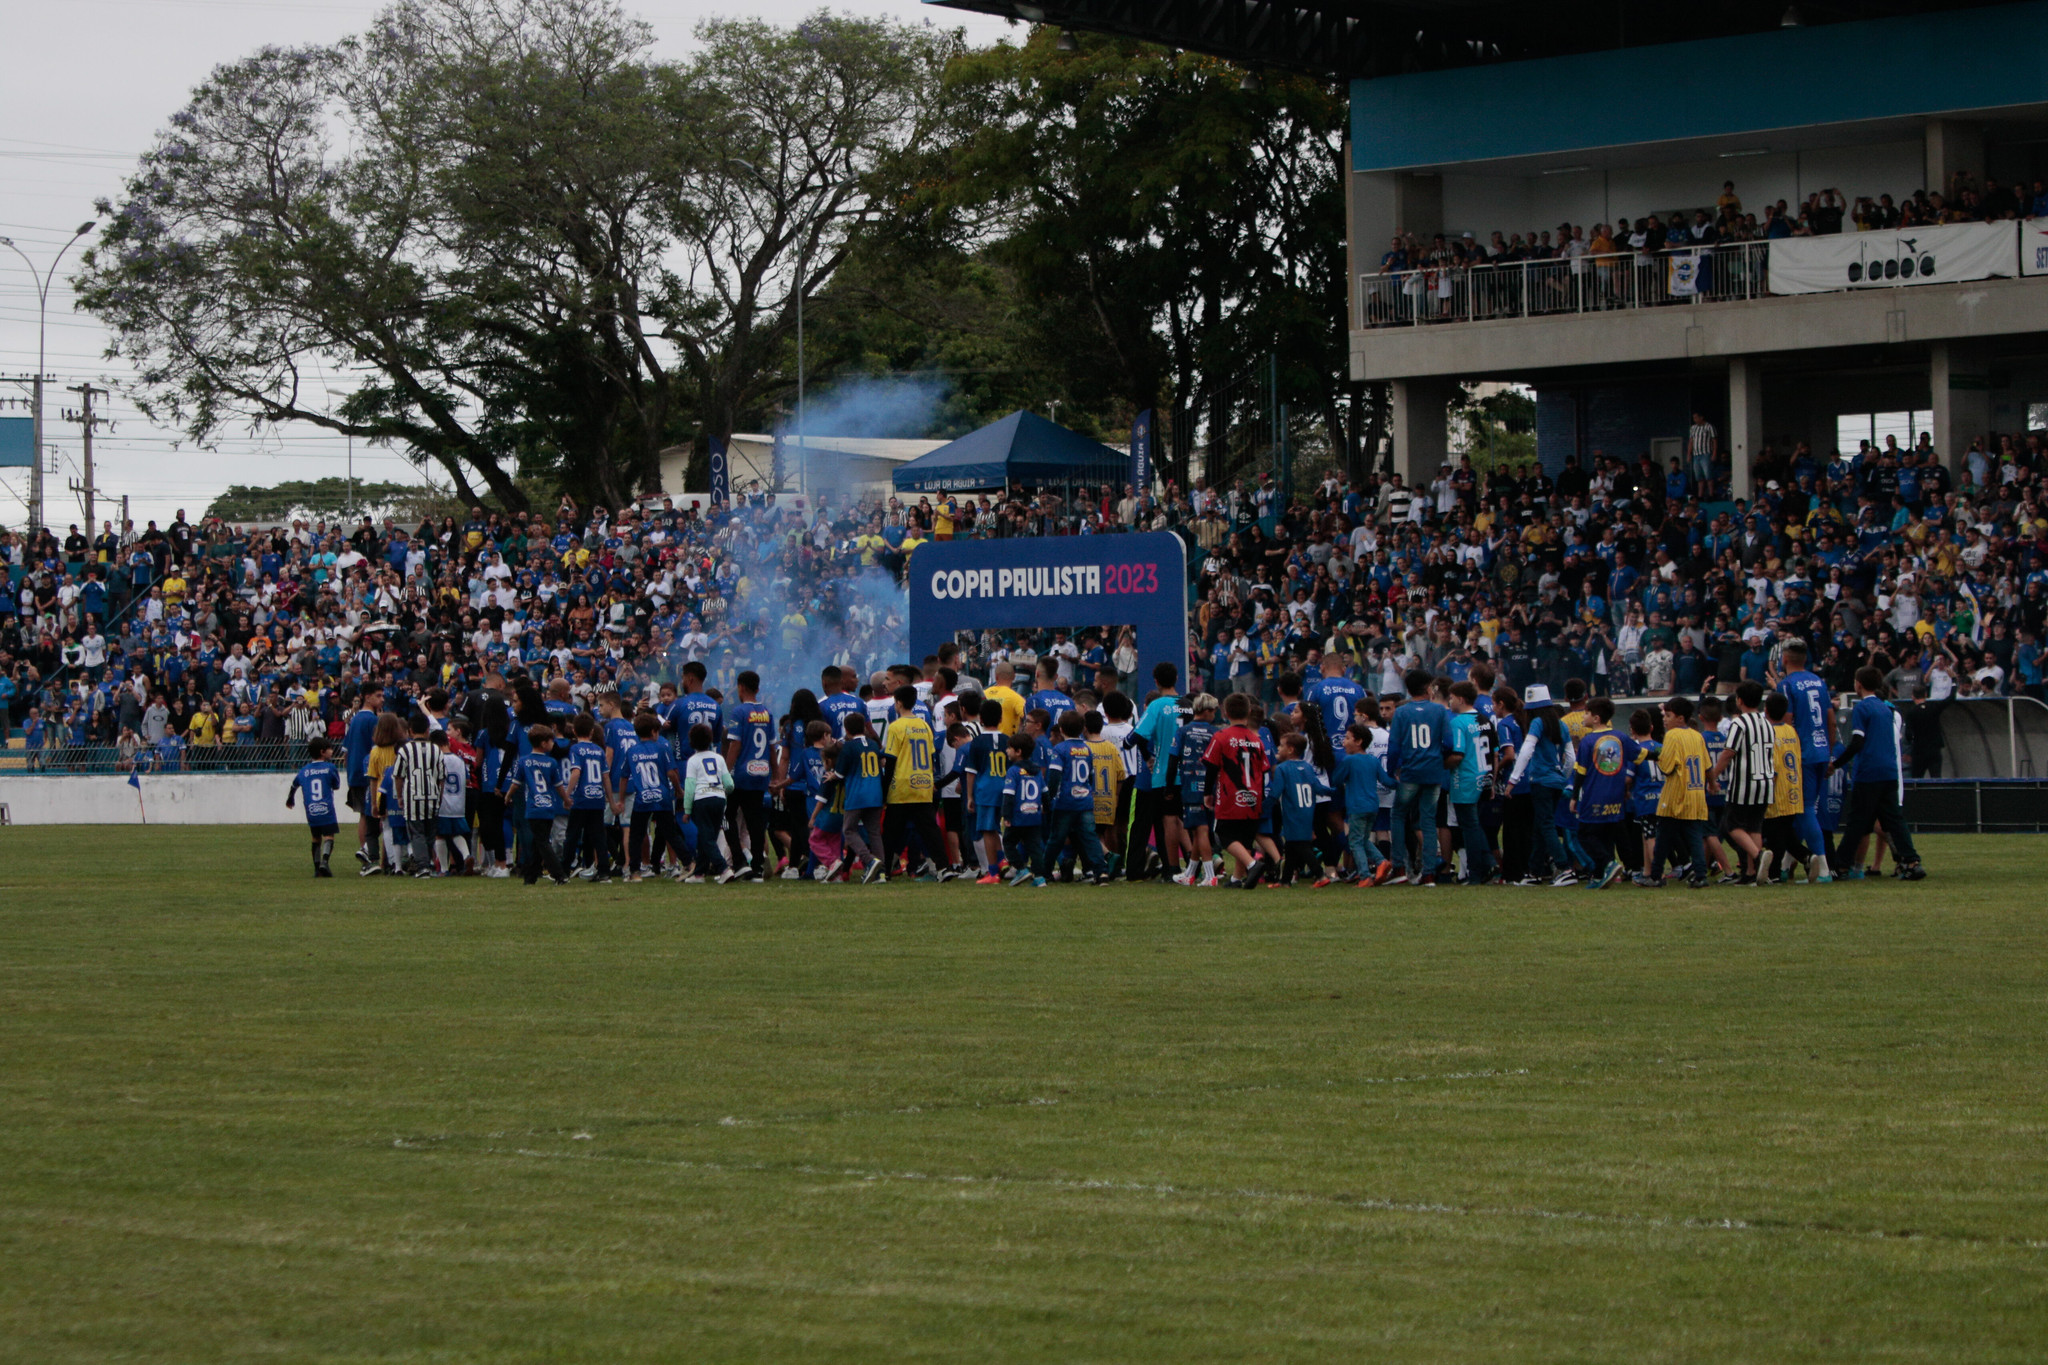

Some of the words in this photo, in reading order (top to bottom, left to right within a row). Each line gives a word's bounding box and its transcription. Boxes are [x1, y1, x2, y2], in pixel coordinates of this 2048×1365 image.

[1848, 238, 1936, 282] diadora
[924, 481, 941, 490] LOJA
[942, 480, 952, 489] DA
[931, 569, 994, 600] COPA
[999, 565, 1100, 597] PAULISTA
[1105, 563, 1159, 594] 2023
[1332, 687, 1356, 695] Sicredi
[696, 702, 716, 710] Sicredi
[1333, 696, 1349, 731] 9
[1807, 689, 1823, 727] 5
[753, 728, 767, 759] 9
[1238, 739, 1260, 748] Sicredi
[1411, 723, 1431, 749] 10
[860, 751, 880, 778] 10
[909, 739, 930, 771] 10
[989, 751, 1007, 777] 10
[1472, 735, 1494, 773] 12
[561, 758, 571, 780] 8
[585, 759, 602, 783] 10
[635, 761, 661, 789] 10
[1072, 760, 1090, 783] 10
[1241, 752, 1252, 788] 1
[1686, 755, 1703, 790] 11
[1784, 751, 1798, 784] 9
[311, 778, 323, 801] 9
[412, 768, 439, 800] 11
[447, 772, 460, 794] 9
[533, 769, 548, 793] 9
[1021, 779, 1039, 801] 10
[1092, 766, 1113, 798] 11
[1296, 783, 1313, 808] 10
